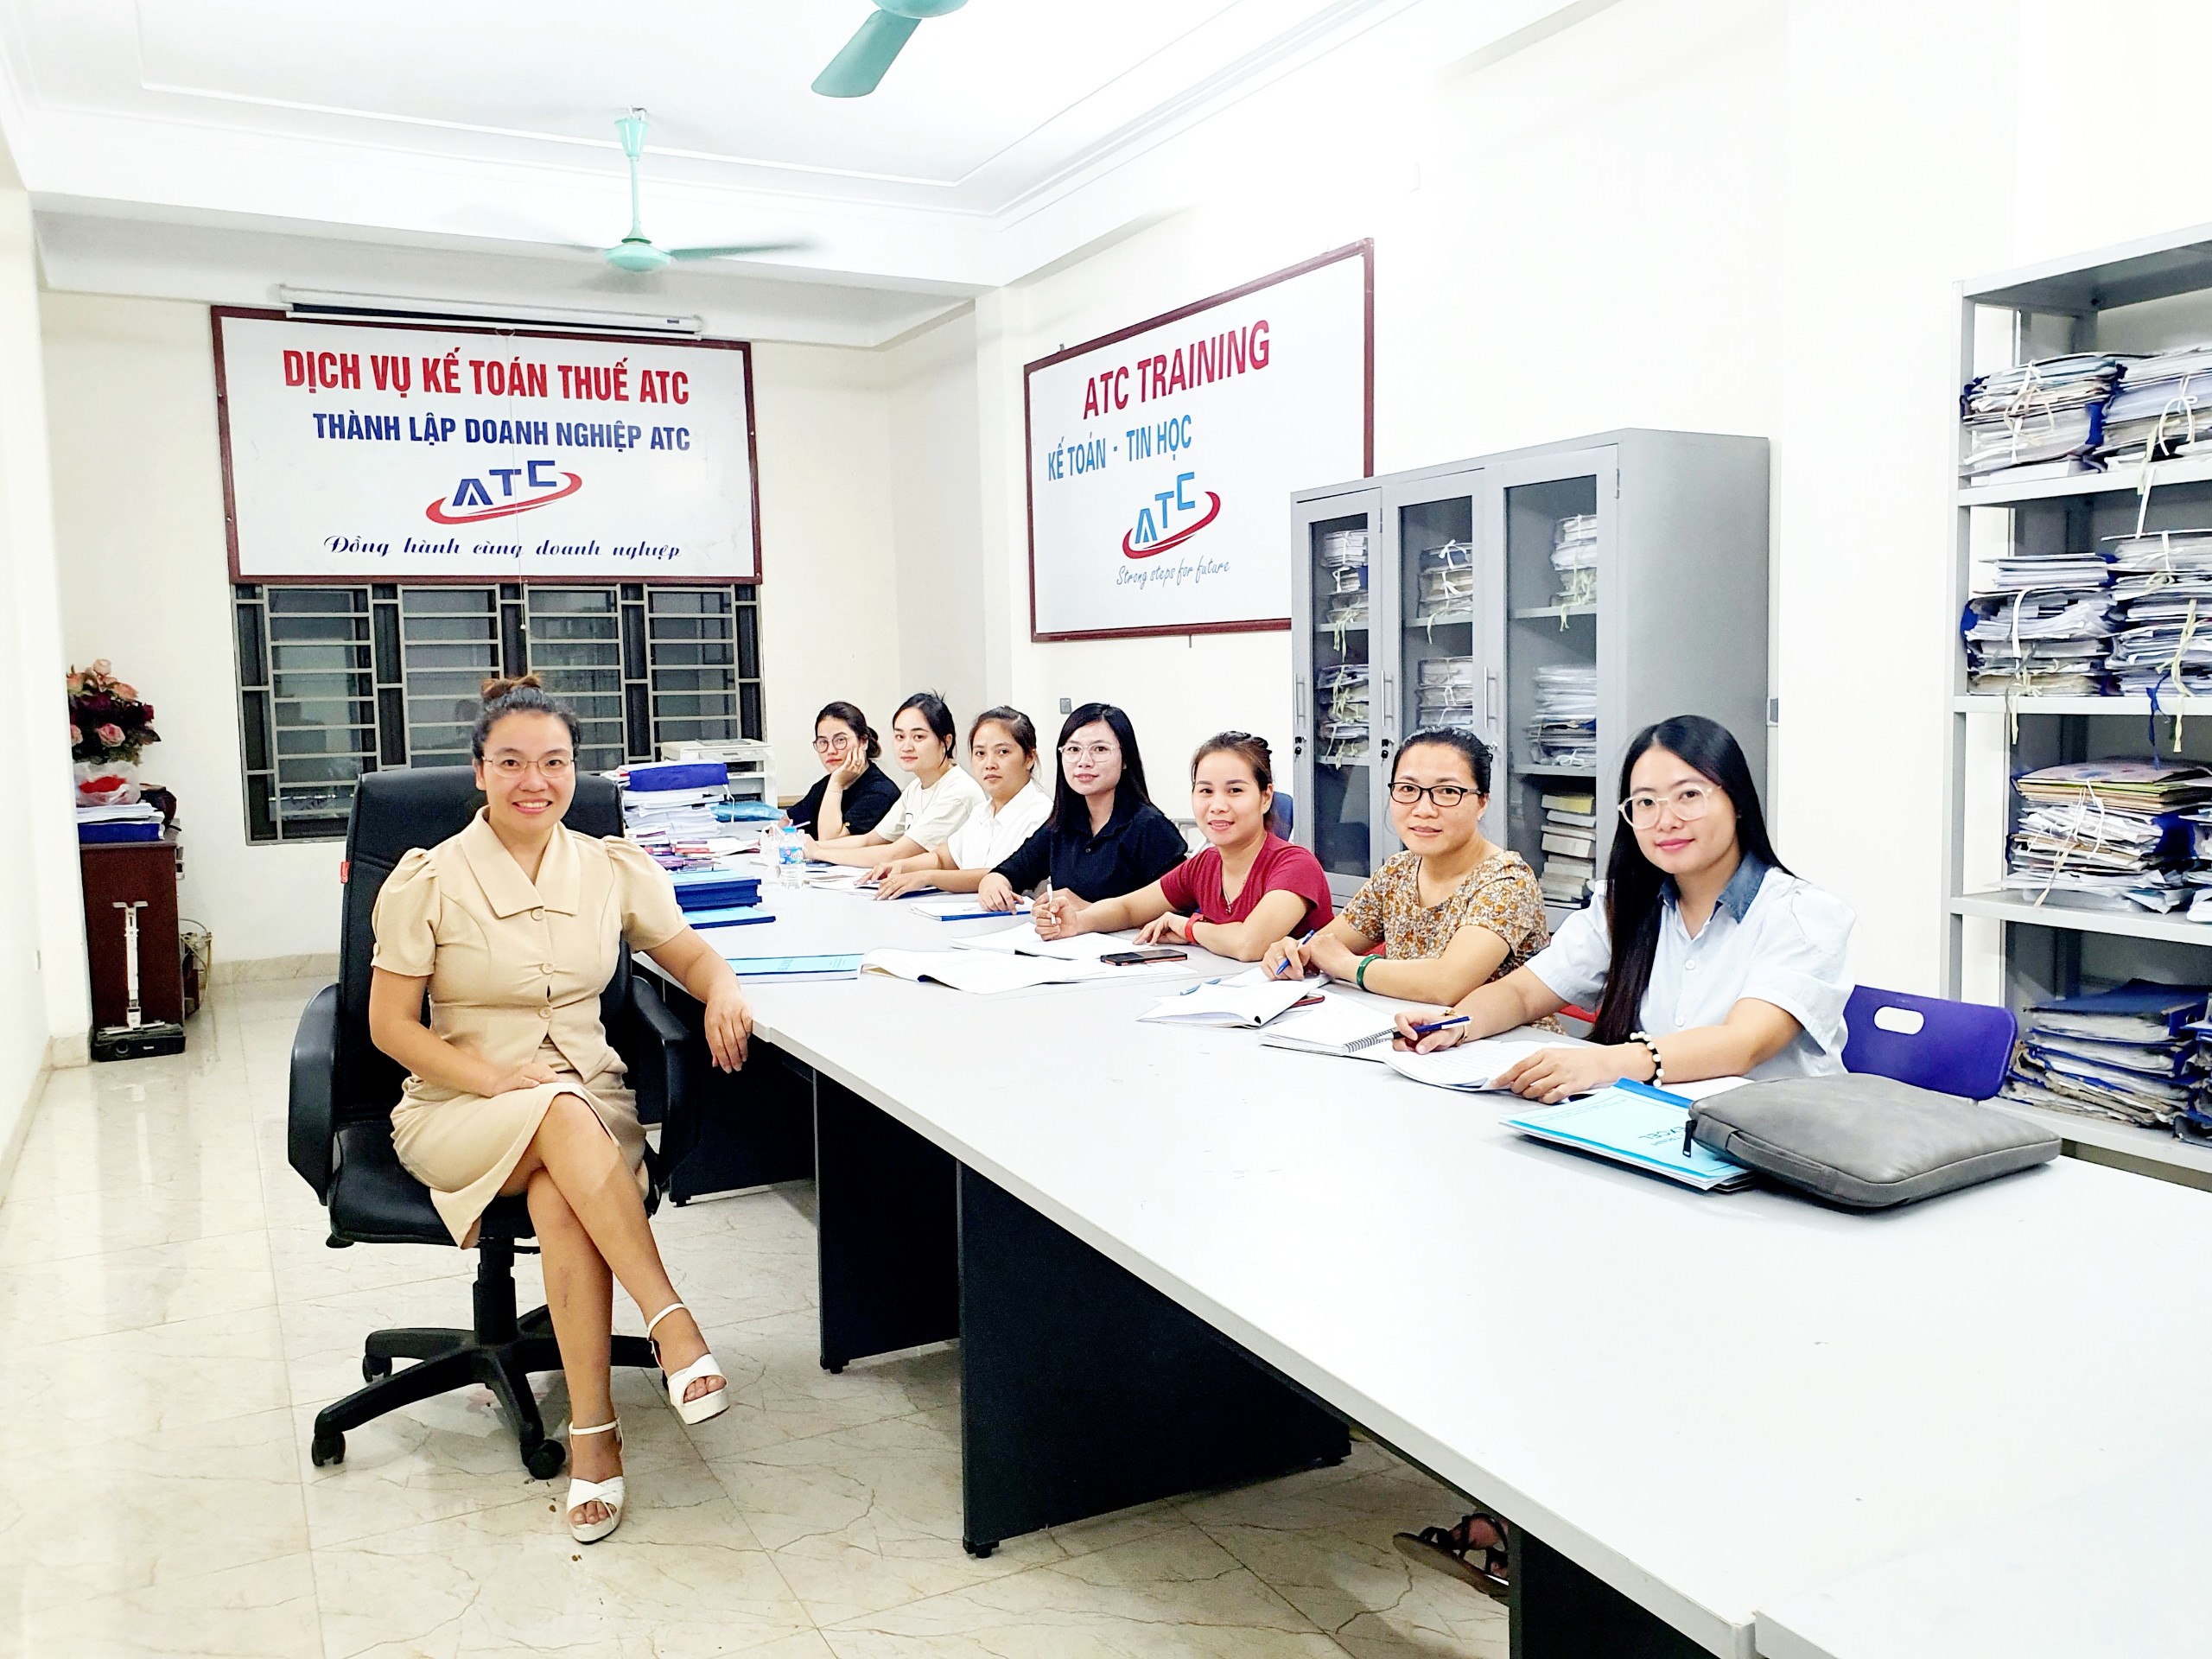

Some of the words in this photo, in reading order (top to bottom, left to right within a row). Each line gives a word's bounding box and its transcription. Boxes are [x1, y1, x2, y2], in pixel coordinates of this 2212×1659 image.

[283, 349, 361, 394] DỊCH
[370, 354, 411, 398] VỤ
[422, 346, 461, 394] KẾ
[468, 355, 548, 398] TOÁN
[556, 356, 629, 402] THUẾ
[639, 369, 690, 405] ATC
[1083, 365, 1129, 420] ATC
[1136, 320, 1270, 403] TRAINING
[312, 409, 401, 442] THÀNH
[409, 411, 456, 446] LẬP
[464, 418, 549, 446] DOANH
[556, 420, 642, 453] NGHIỆP
[650, 426, 690, 450] ATC
[1048, 436, 1065, 481] KẾ
[1068, 431, 1106, 476] TOÁN
[1126, 425, 1152, 462] TIN
[1157, 414, 1192, 461] HỌC
[452, 460, 557, 507] ATC
[1135, 471, 1196, 544] ATC
[323, 536, 390, 557] Đồng
[404, 537, 461, 554] hành
[473, 538, 523, 558] cùng
[536, 539, 601, 556] doanh
[1116, 565, 1148, 590] Strong
[1150, 565, 1176, 588] steps
[1176, 557, 1193, 586] for
[1195, 555, 1230, 584] future
